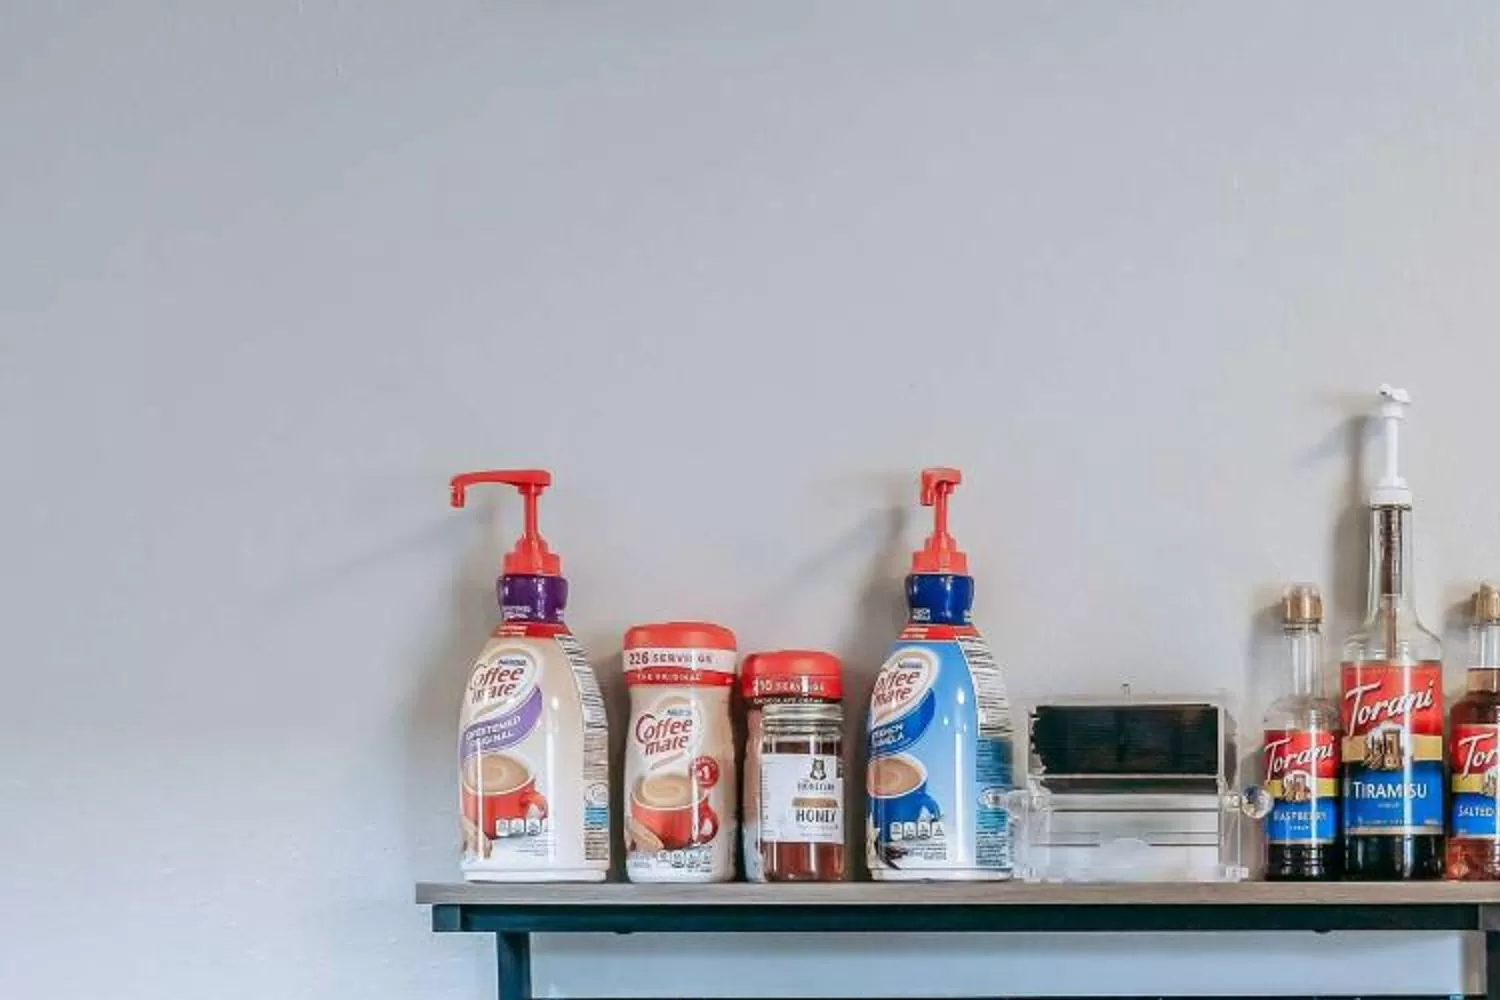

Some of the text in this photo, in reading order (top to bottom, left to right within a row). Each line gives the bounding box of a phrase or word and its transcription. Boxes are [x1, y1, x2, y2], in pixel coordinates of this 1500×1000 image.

[1345, 679, 1434, 737] Torani
[636, 713, 693, 744] Coffee
[645, 736, 688, 757] mate
[1264, 735, 1335, 782] Torani
[1353, 782, 1428, 799] TIRAMISU
